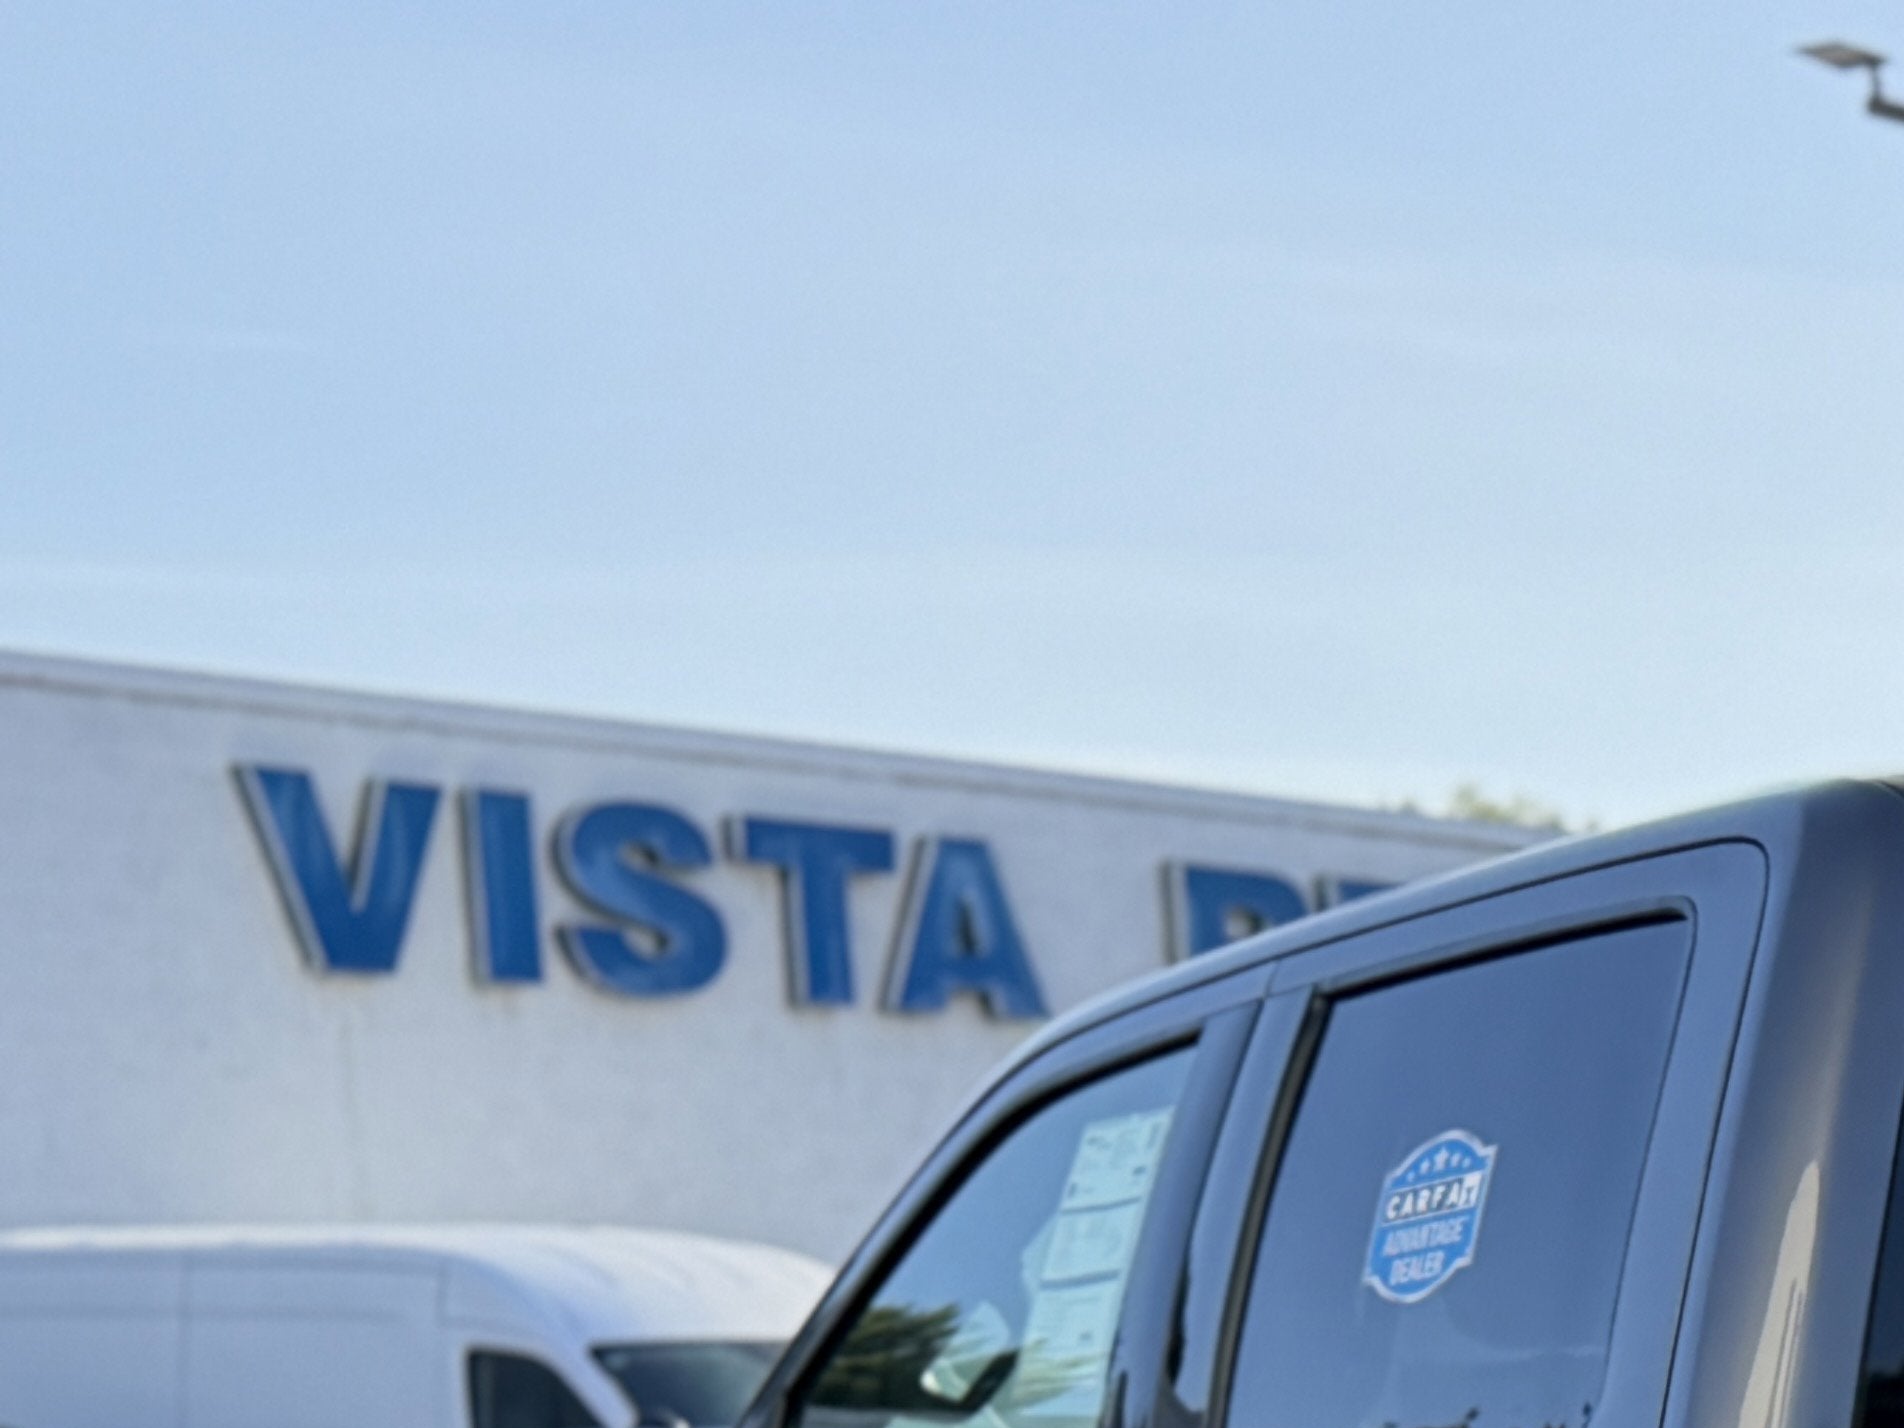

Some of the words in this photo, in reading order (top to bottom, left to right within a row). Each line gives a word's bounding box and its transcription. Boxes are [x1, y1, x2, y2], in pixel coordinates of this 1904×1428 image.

[233, 762, 1052, 1021] VISTA
[1384, 1218, 1466, 1256] ADVANTAGE
[1389, 1250, 1446, 1286] DEALER
